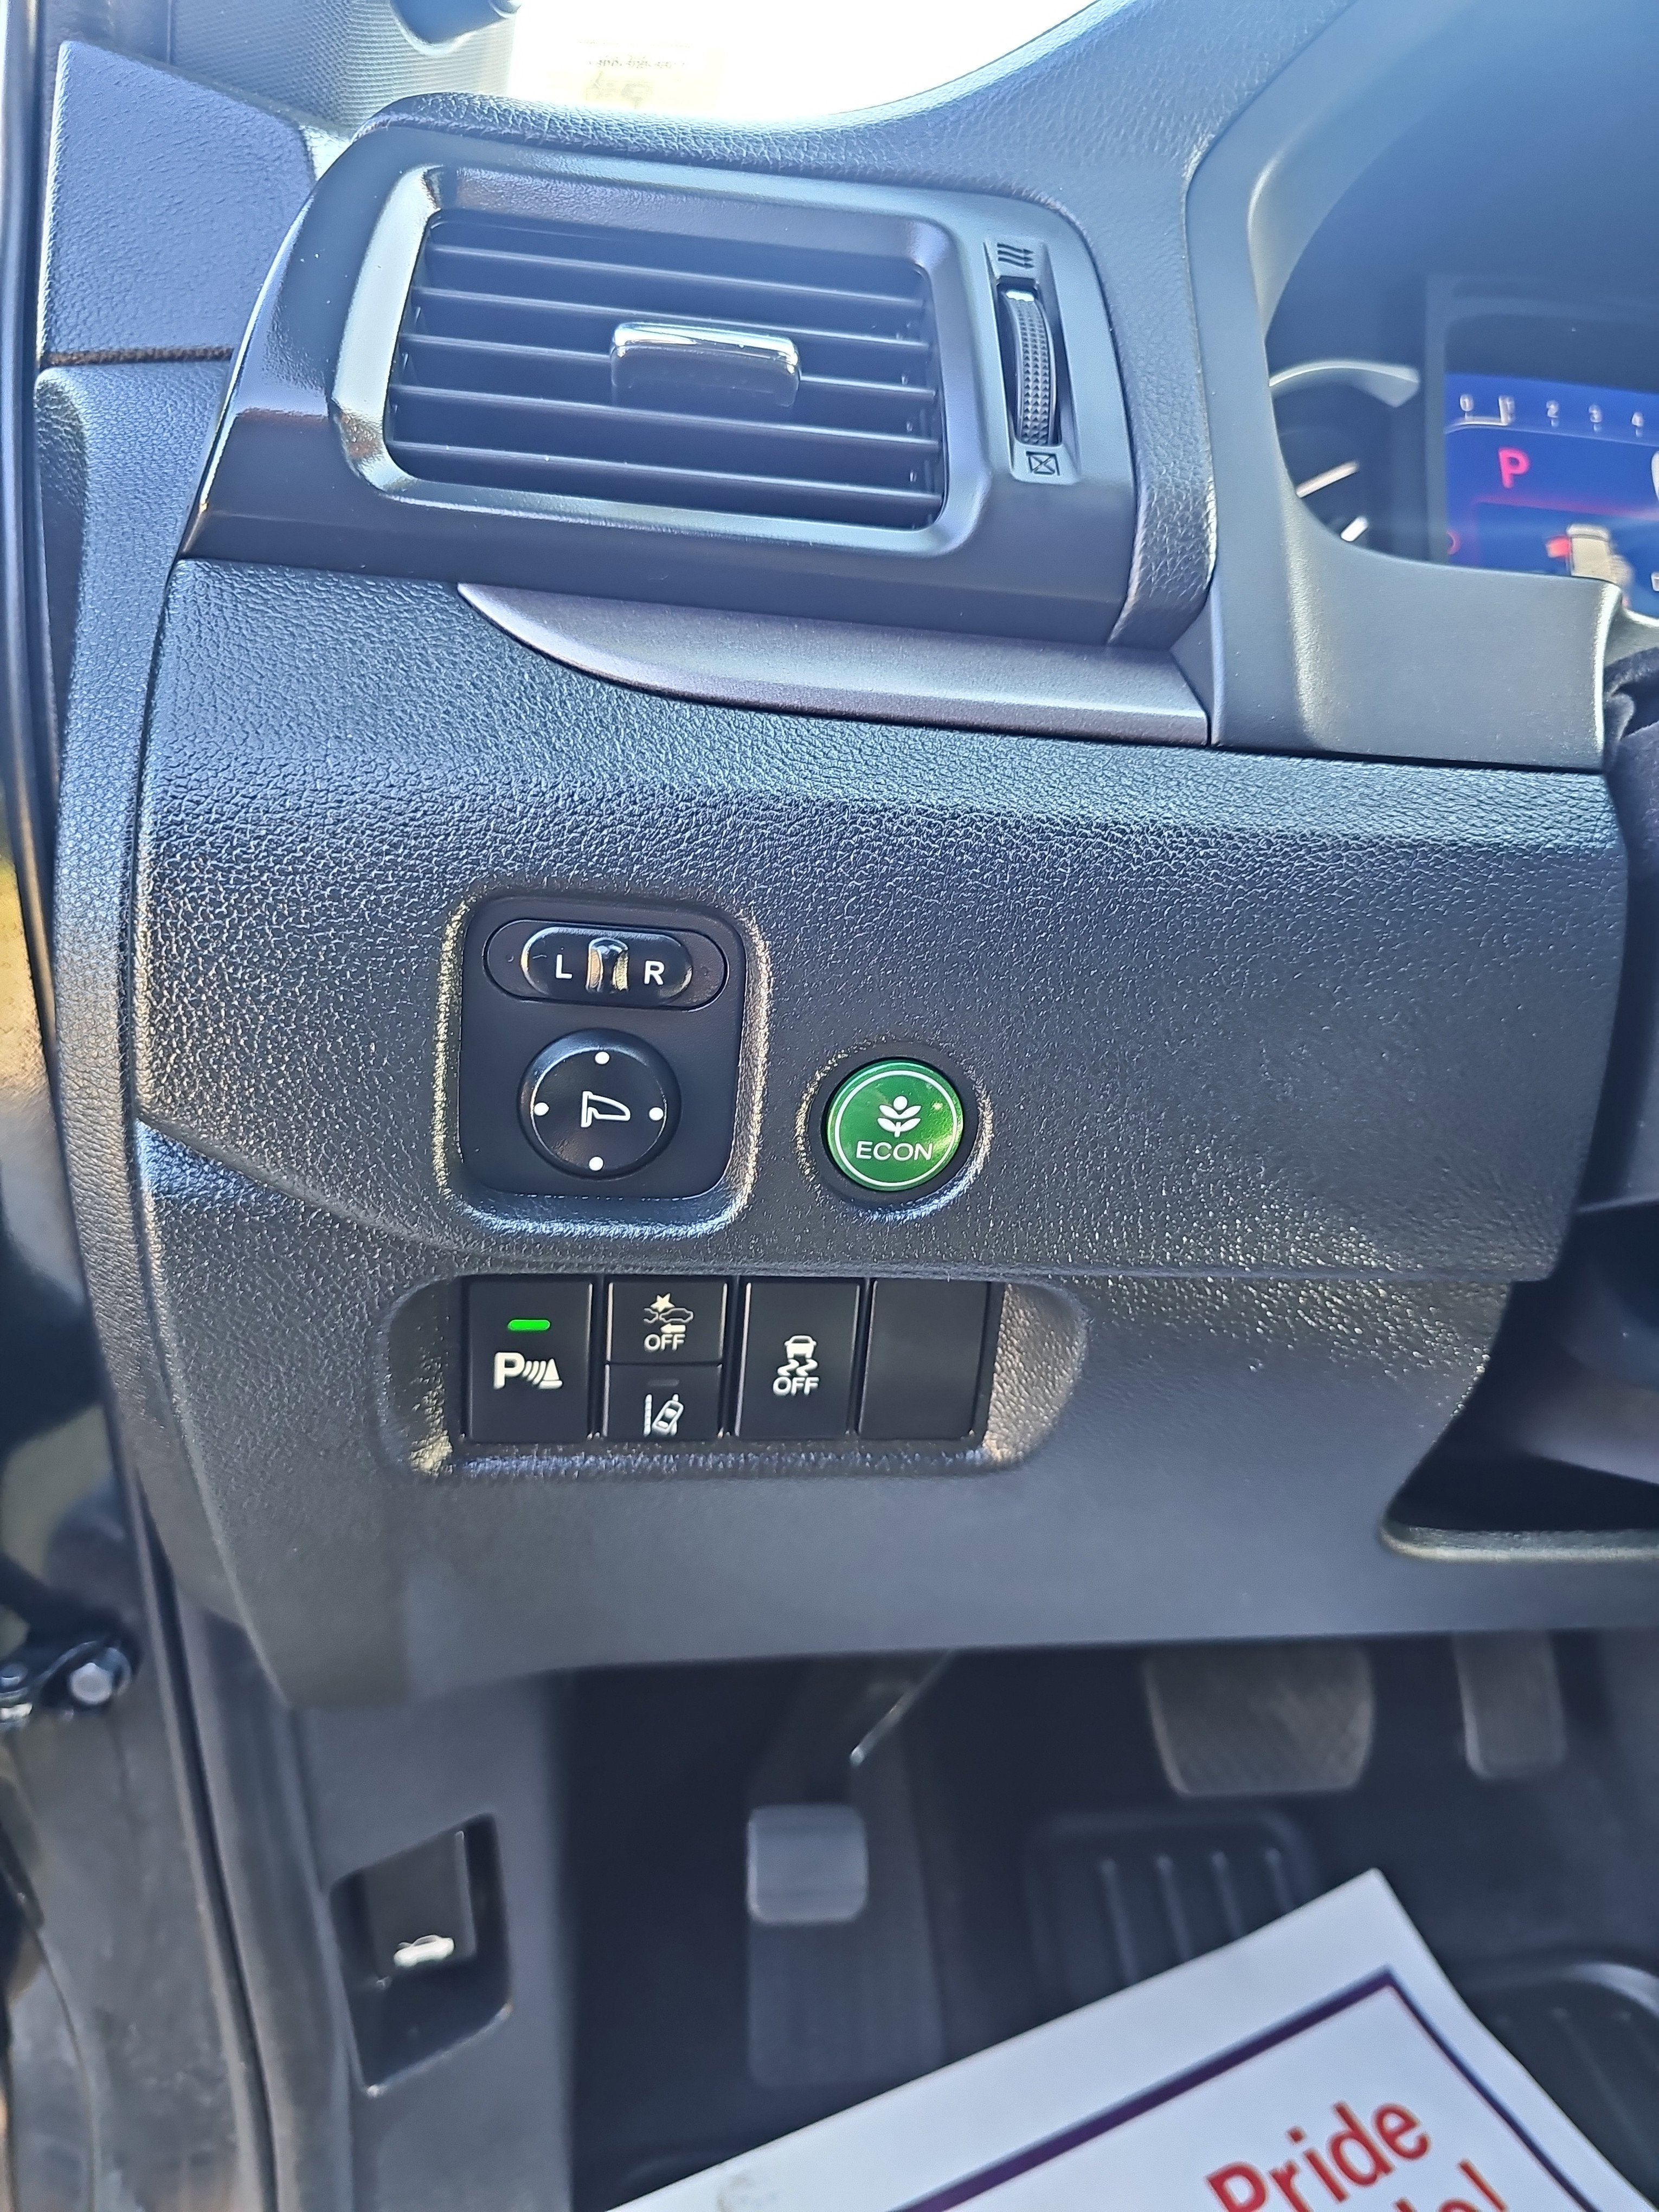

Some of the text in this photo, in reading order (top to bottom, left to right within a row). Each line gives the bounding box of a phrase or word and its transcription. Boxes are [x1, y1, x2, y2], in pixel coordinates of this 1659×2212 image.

[1498, 448, 1530, 488] P
[556, 954, 665, 985] L R
[855, 1140, 933, 1163] ECON
[644, 1334, 686, 1351] OFF
[493, 1352, 525, 1390] P
[773, 1377, 819, 1396] OFF
[1204, 2101, 1431, 2212] Pride
